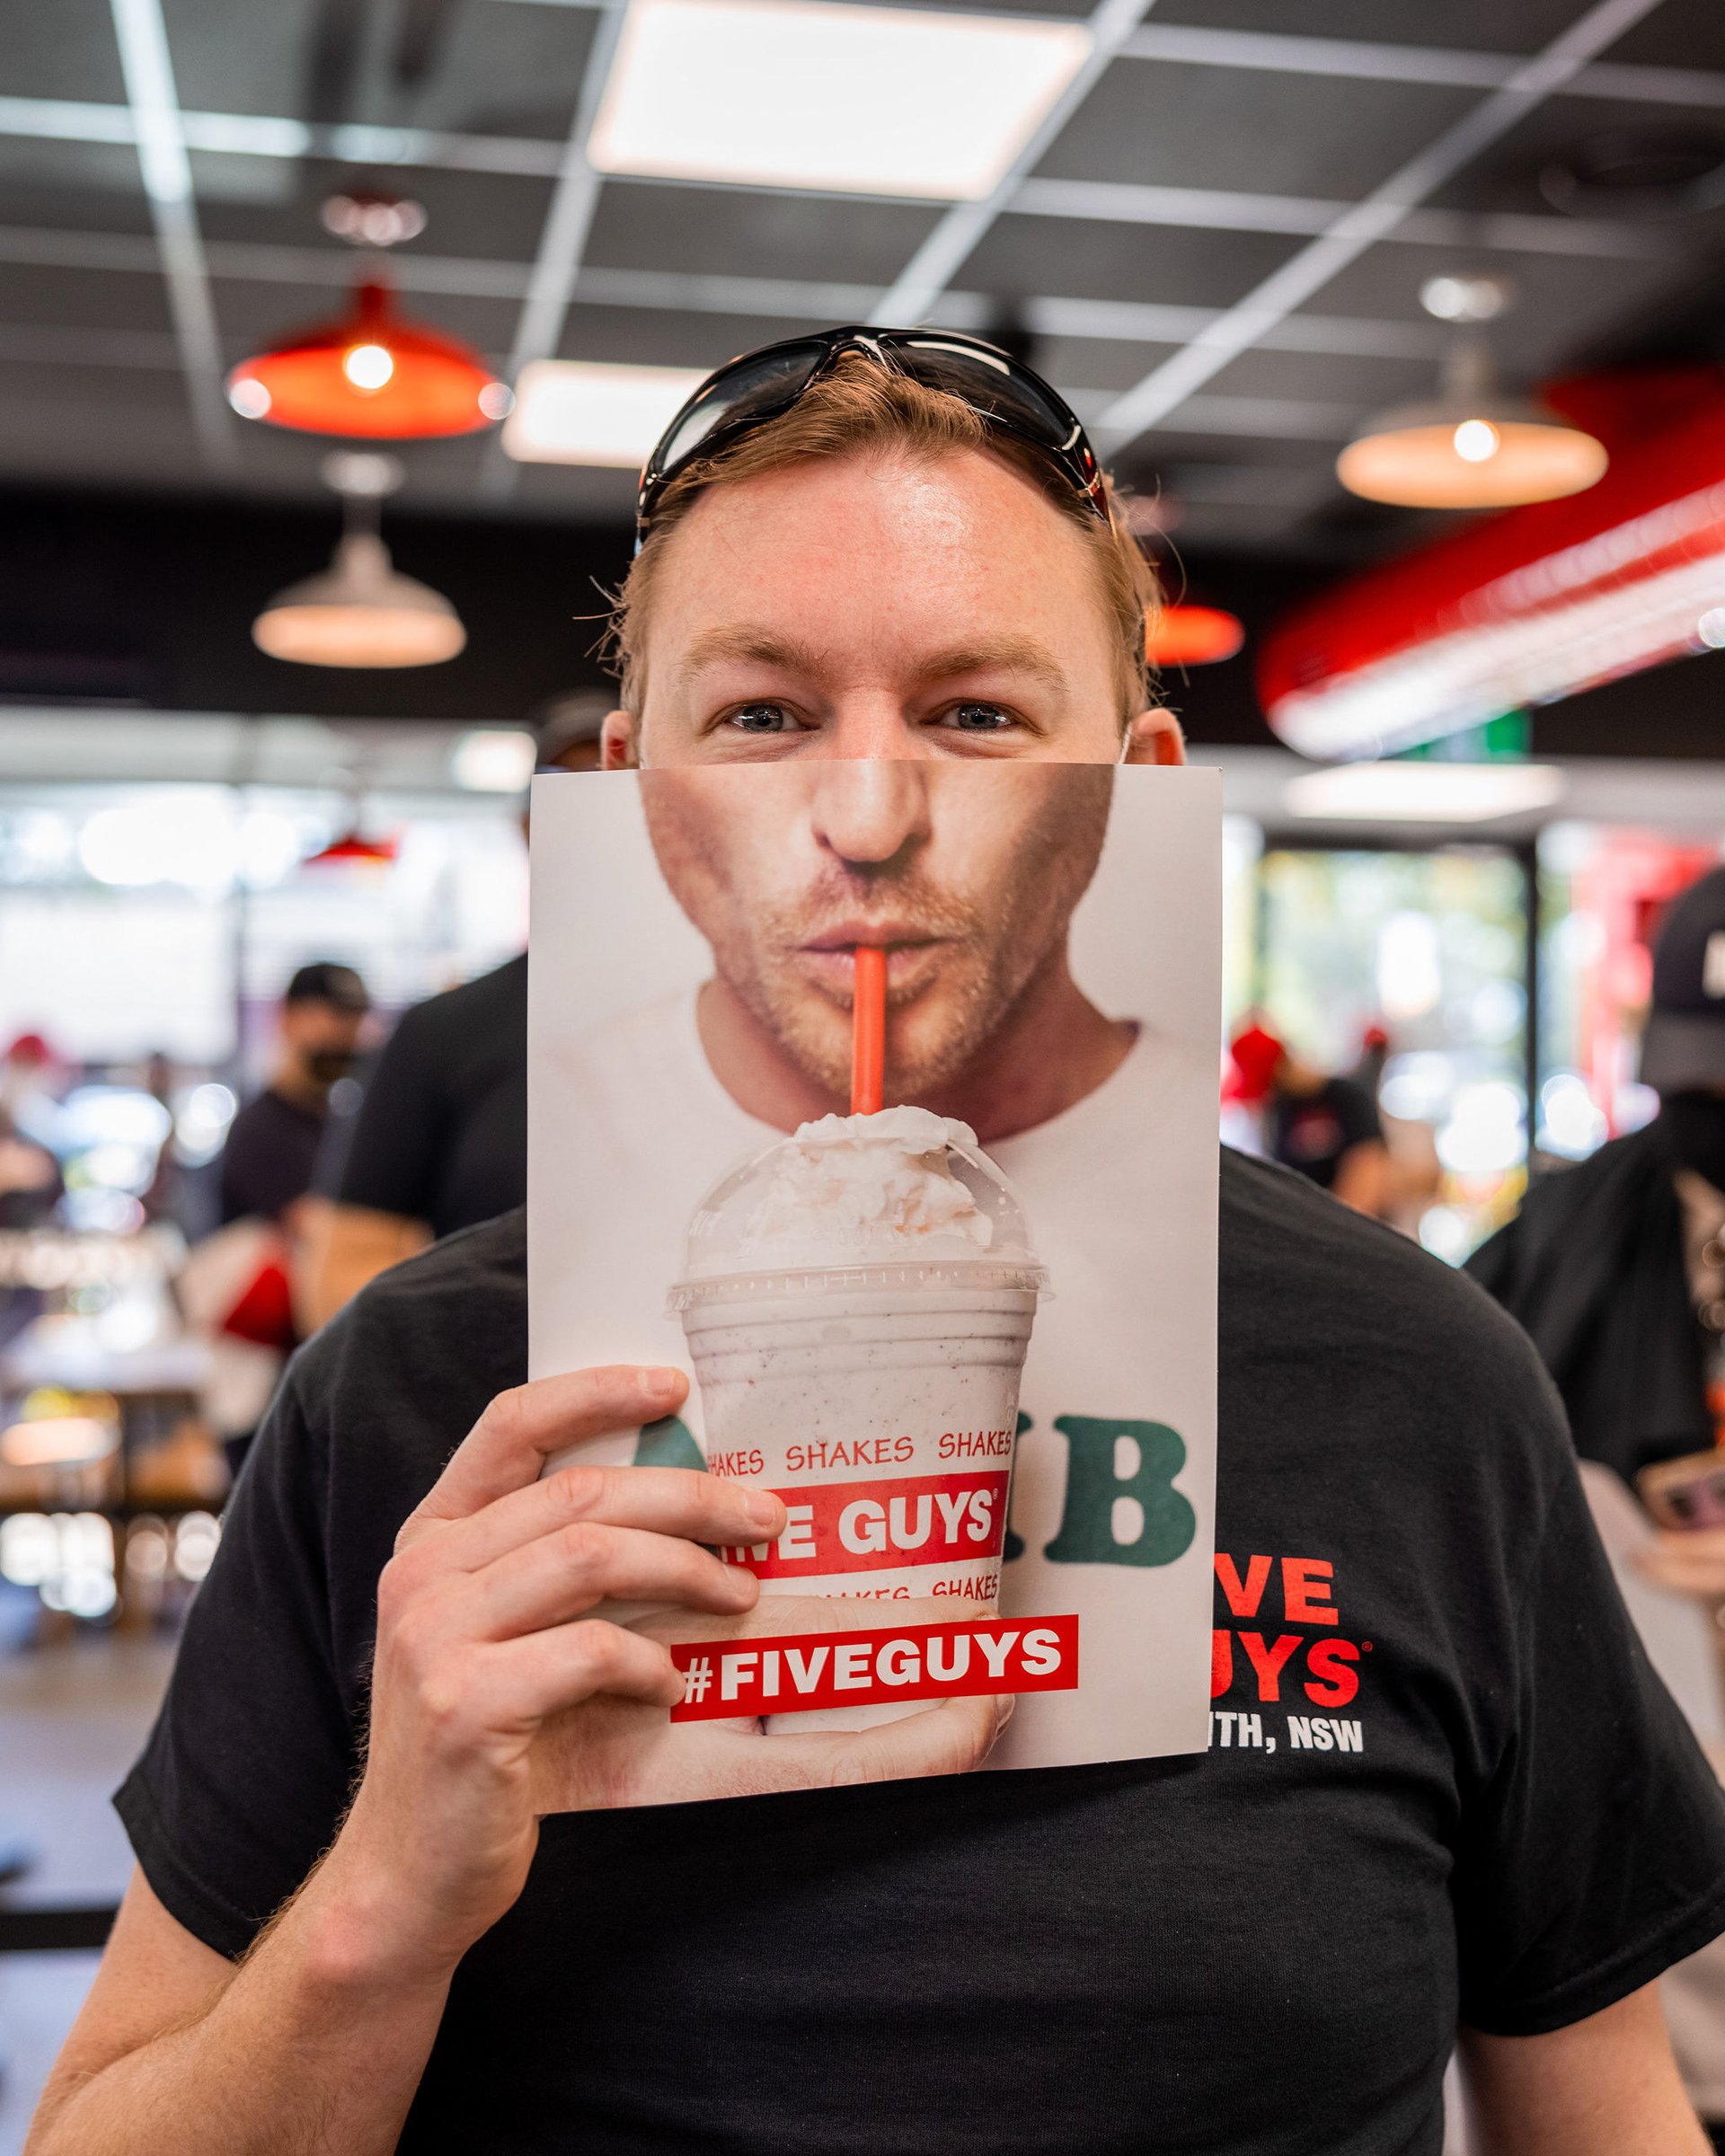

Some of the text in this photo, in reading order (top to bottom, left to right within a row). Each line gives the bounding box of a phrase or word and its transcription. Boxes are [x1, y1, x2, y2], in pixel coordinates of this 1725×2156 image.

[785, 1436, 915, 1471] SHAKES
[938, 1430, 1012, 1459] SHAKES
[685, 1629, 1061, 1703] #FIVEGUYS
[1287, 1715, 1364, 1752] NSW
